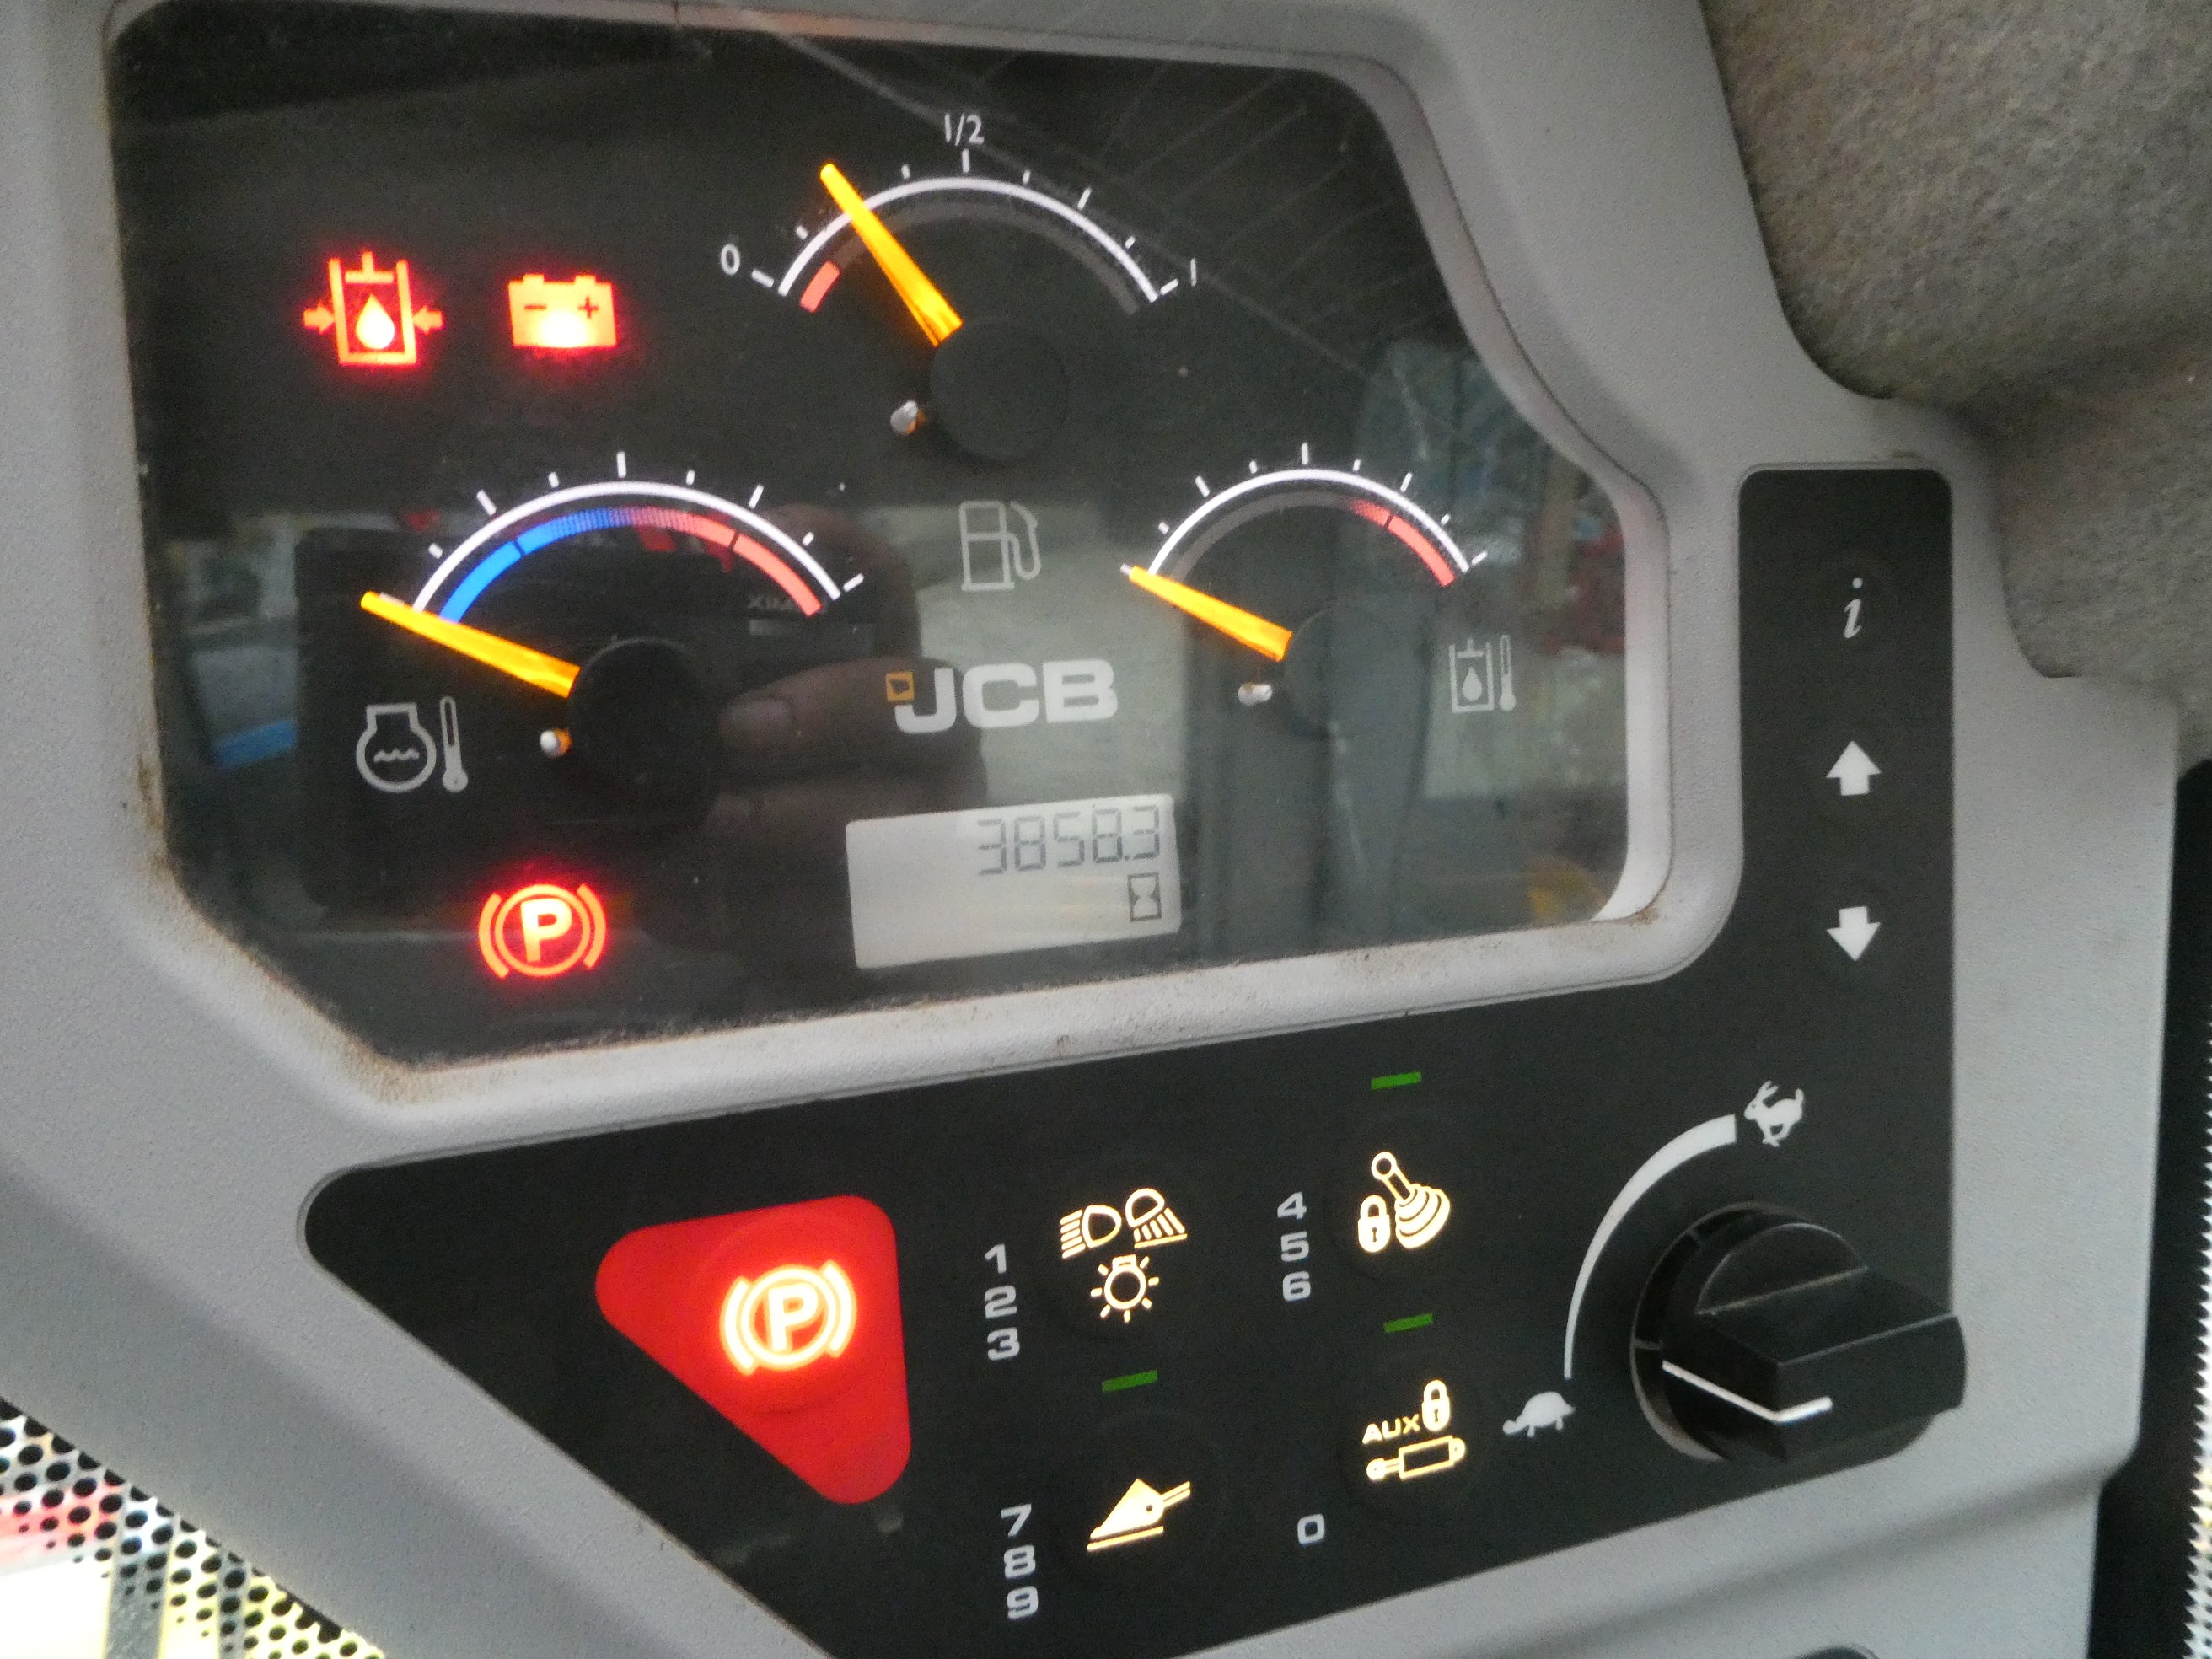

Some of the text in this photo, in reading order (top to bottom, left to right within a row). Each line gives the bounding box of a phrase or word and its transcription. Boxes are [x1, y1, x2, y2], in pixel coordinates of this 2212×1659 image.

[721, 244, 741, 276] 0
[894, 658, 1119, 734] JCB
[520, 898, 572, 963] P
[1276, 1191, 1307, 1220] 4
[984, 1243, 1007, 1274] 1
[1280, 1231, 1310, 1262] 5
[984, 1285, 1017, 1319] 2
[1282, 1270, 1312, 1302] 6
[767, 1281, 819, 1352] P
[986, 1327, 1021, 1361] 3
[1361, 1413, 1421, 1444] AUX
[1000, 1503, 1032, 1537] 7
[1003, 1544, 1036, 1579] 8
[1007, 1586, 1039, 1619] 9
